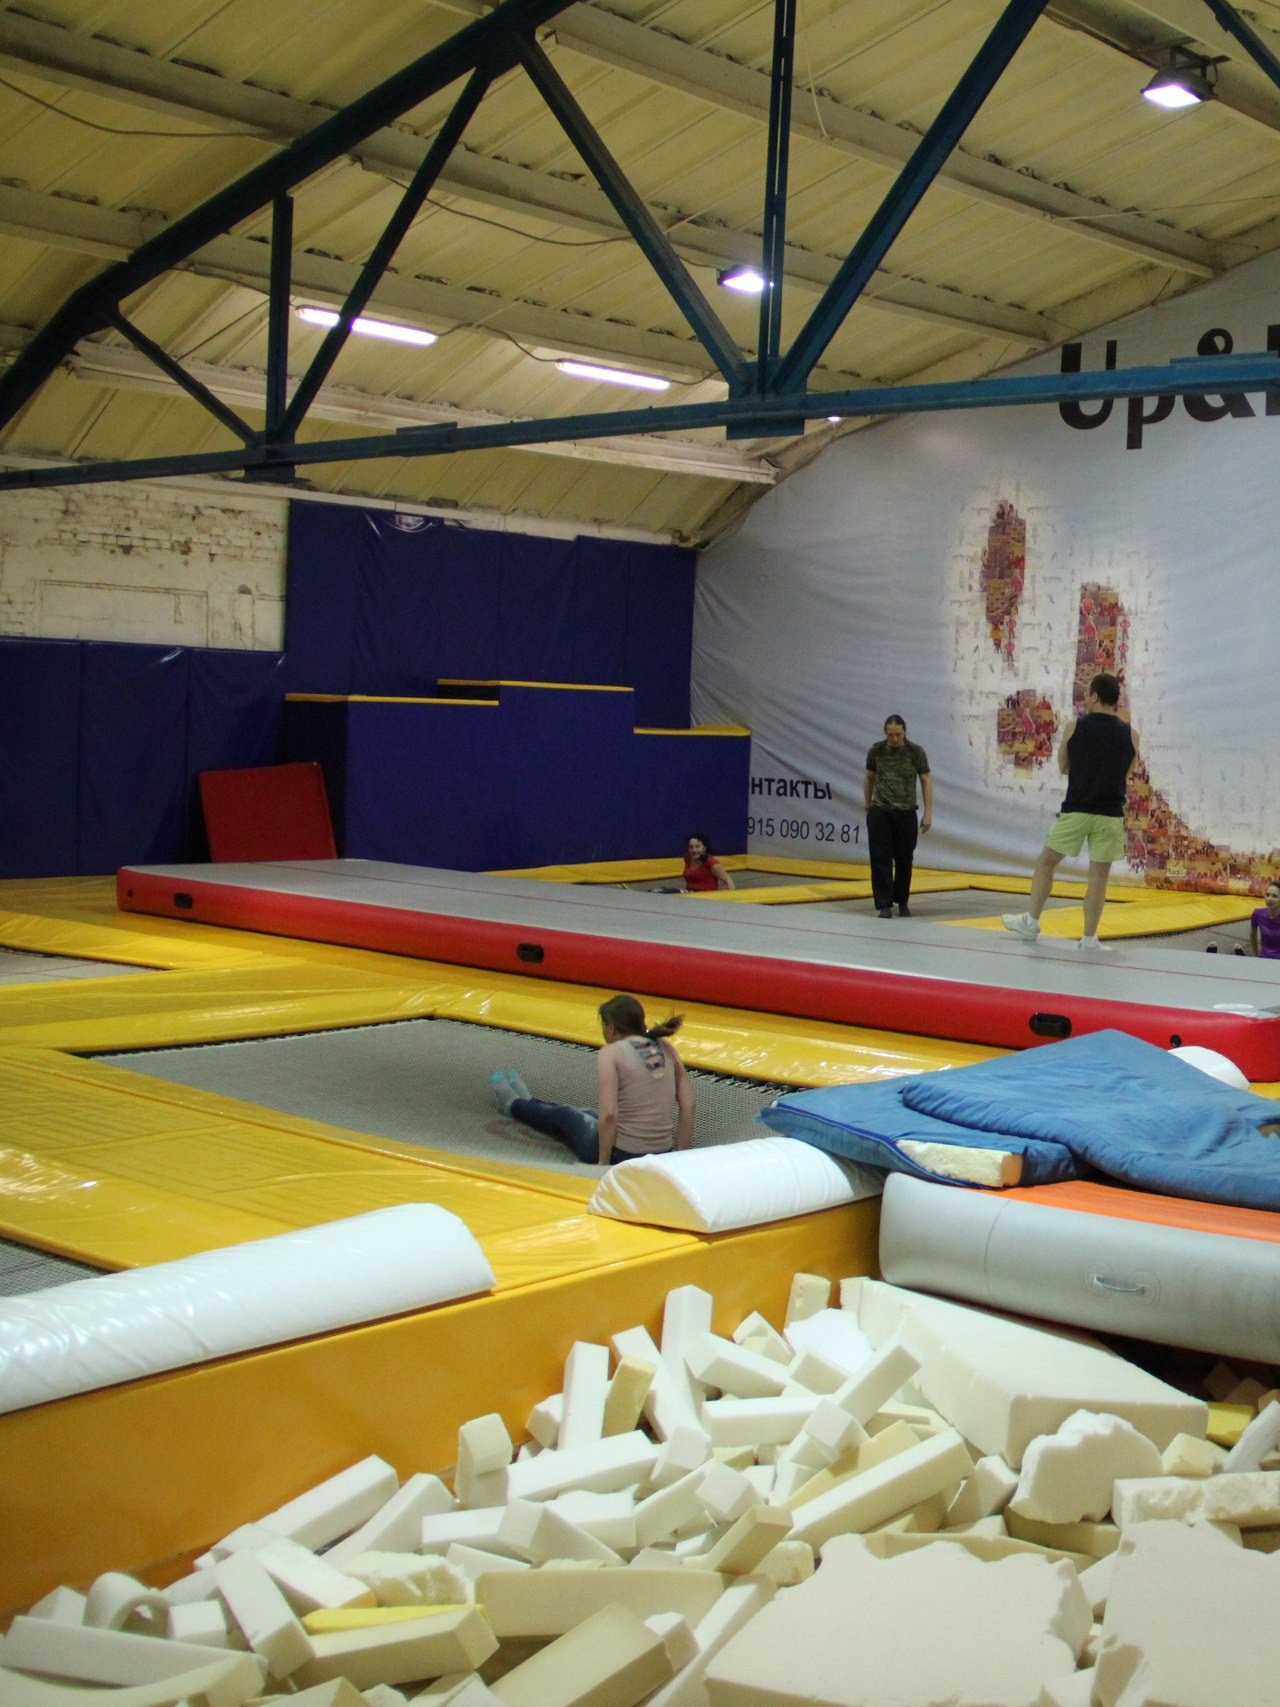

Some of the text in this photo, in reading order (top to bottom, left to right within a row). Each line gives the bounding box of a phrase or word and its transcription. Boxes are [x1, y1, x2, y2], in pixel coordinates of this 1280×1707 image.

[748, 816, 860, 844] 915 090 32 81
